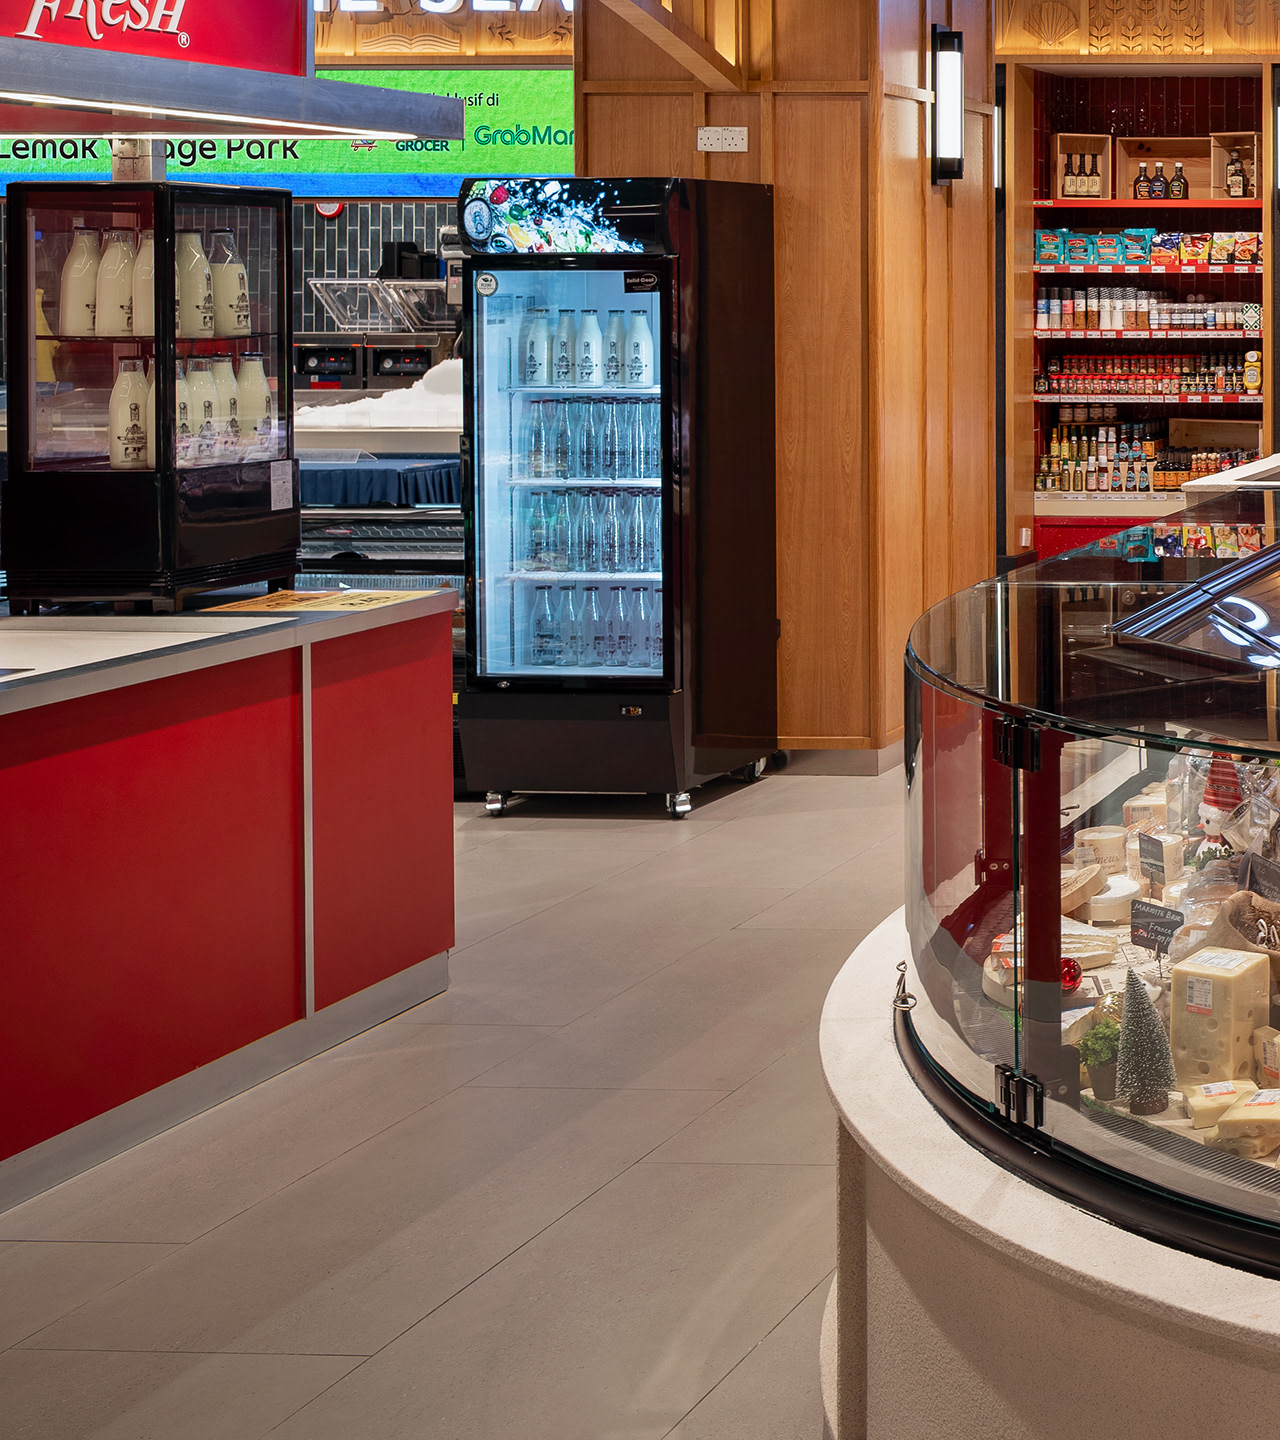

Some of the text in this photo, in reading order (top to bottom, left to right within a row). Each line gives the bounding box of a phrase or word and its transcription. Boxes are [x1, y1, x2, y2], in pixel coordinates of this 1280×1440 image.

[486, 93, 499, 107] di
[395, 140, 449, 152] GROCER
[1149, 922, 1172, 935] France
